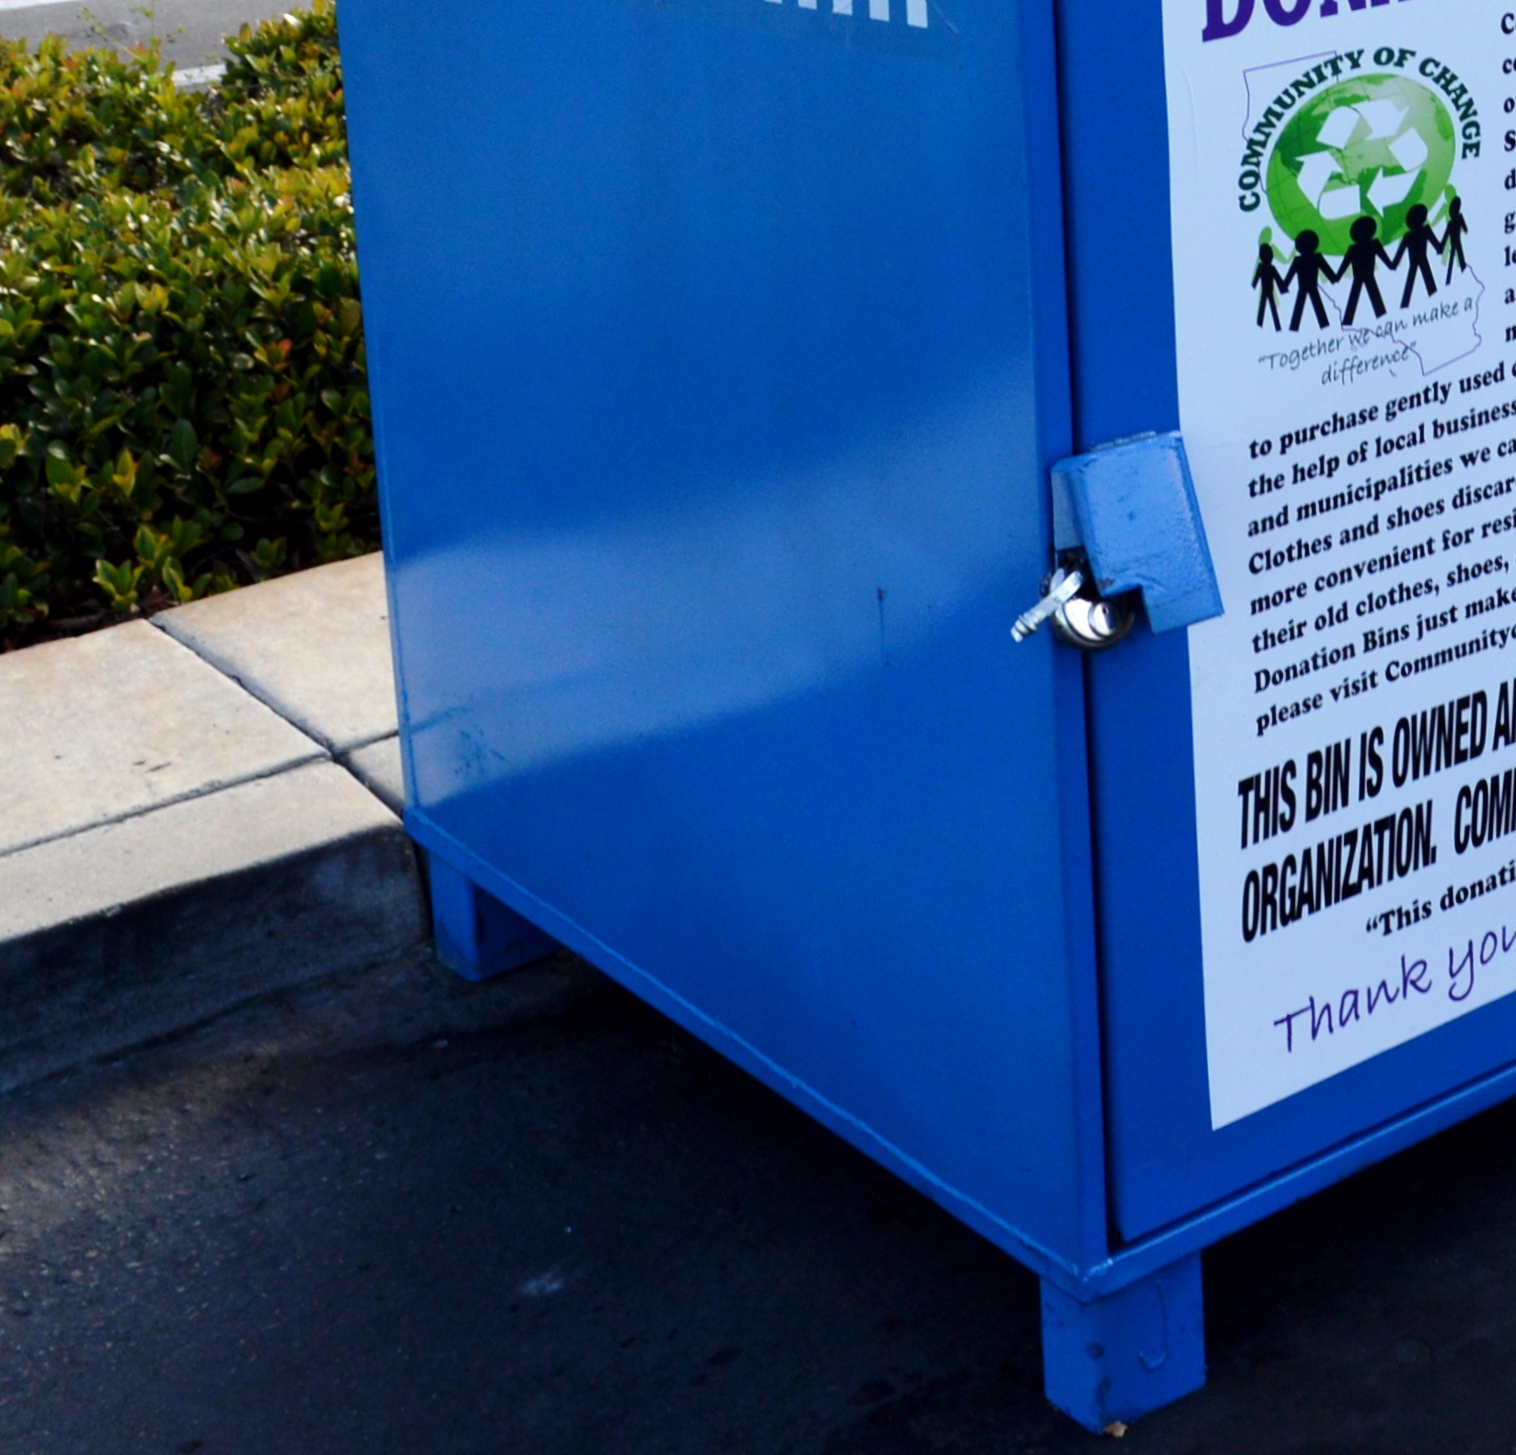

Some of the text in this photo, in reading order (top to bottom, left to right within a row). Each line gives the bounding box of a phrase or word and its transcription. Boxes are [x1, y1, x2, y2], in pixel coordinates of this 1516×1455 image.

[1238, 47, 1481, 213] COMMUNITY OF CHANGE
[1348, 328, 1370, 347] we
[1375, 319, 1407, 339] can
[1412, 300, 1458, 327] make
[1463, 297, 1473, 311] a
[1248, 473, 1285, 499] the
[1292, 454, 1340, 485] help
[1346, 440, 1368, 466] of
[1375, 422, 1425, 458] local
[1254, 643, 1356, 694] Donation
[1362, 624, 1410, 654] Bins
[1416, 605, 1458, 641] just
[1256, 693, 1323, 738] please
[1329, 670, 1379, 703] visit
[1237, 759, 1296, 850] THIS
[1305, 738, 1351, 823] BIN
[1358, 726, 1384, 801] IS
[1392, 690, 1487, 788] OWNED
[1242, 799, 1437, 944] ORGANIZATION.
[1365, 899, 1432, 937] “This
[1272, 954, 1432, 1053] Thank
